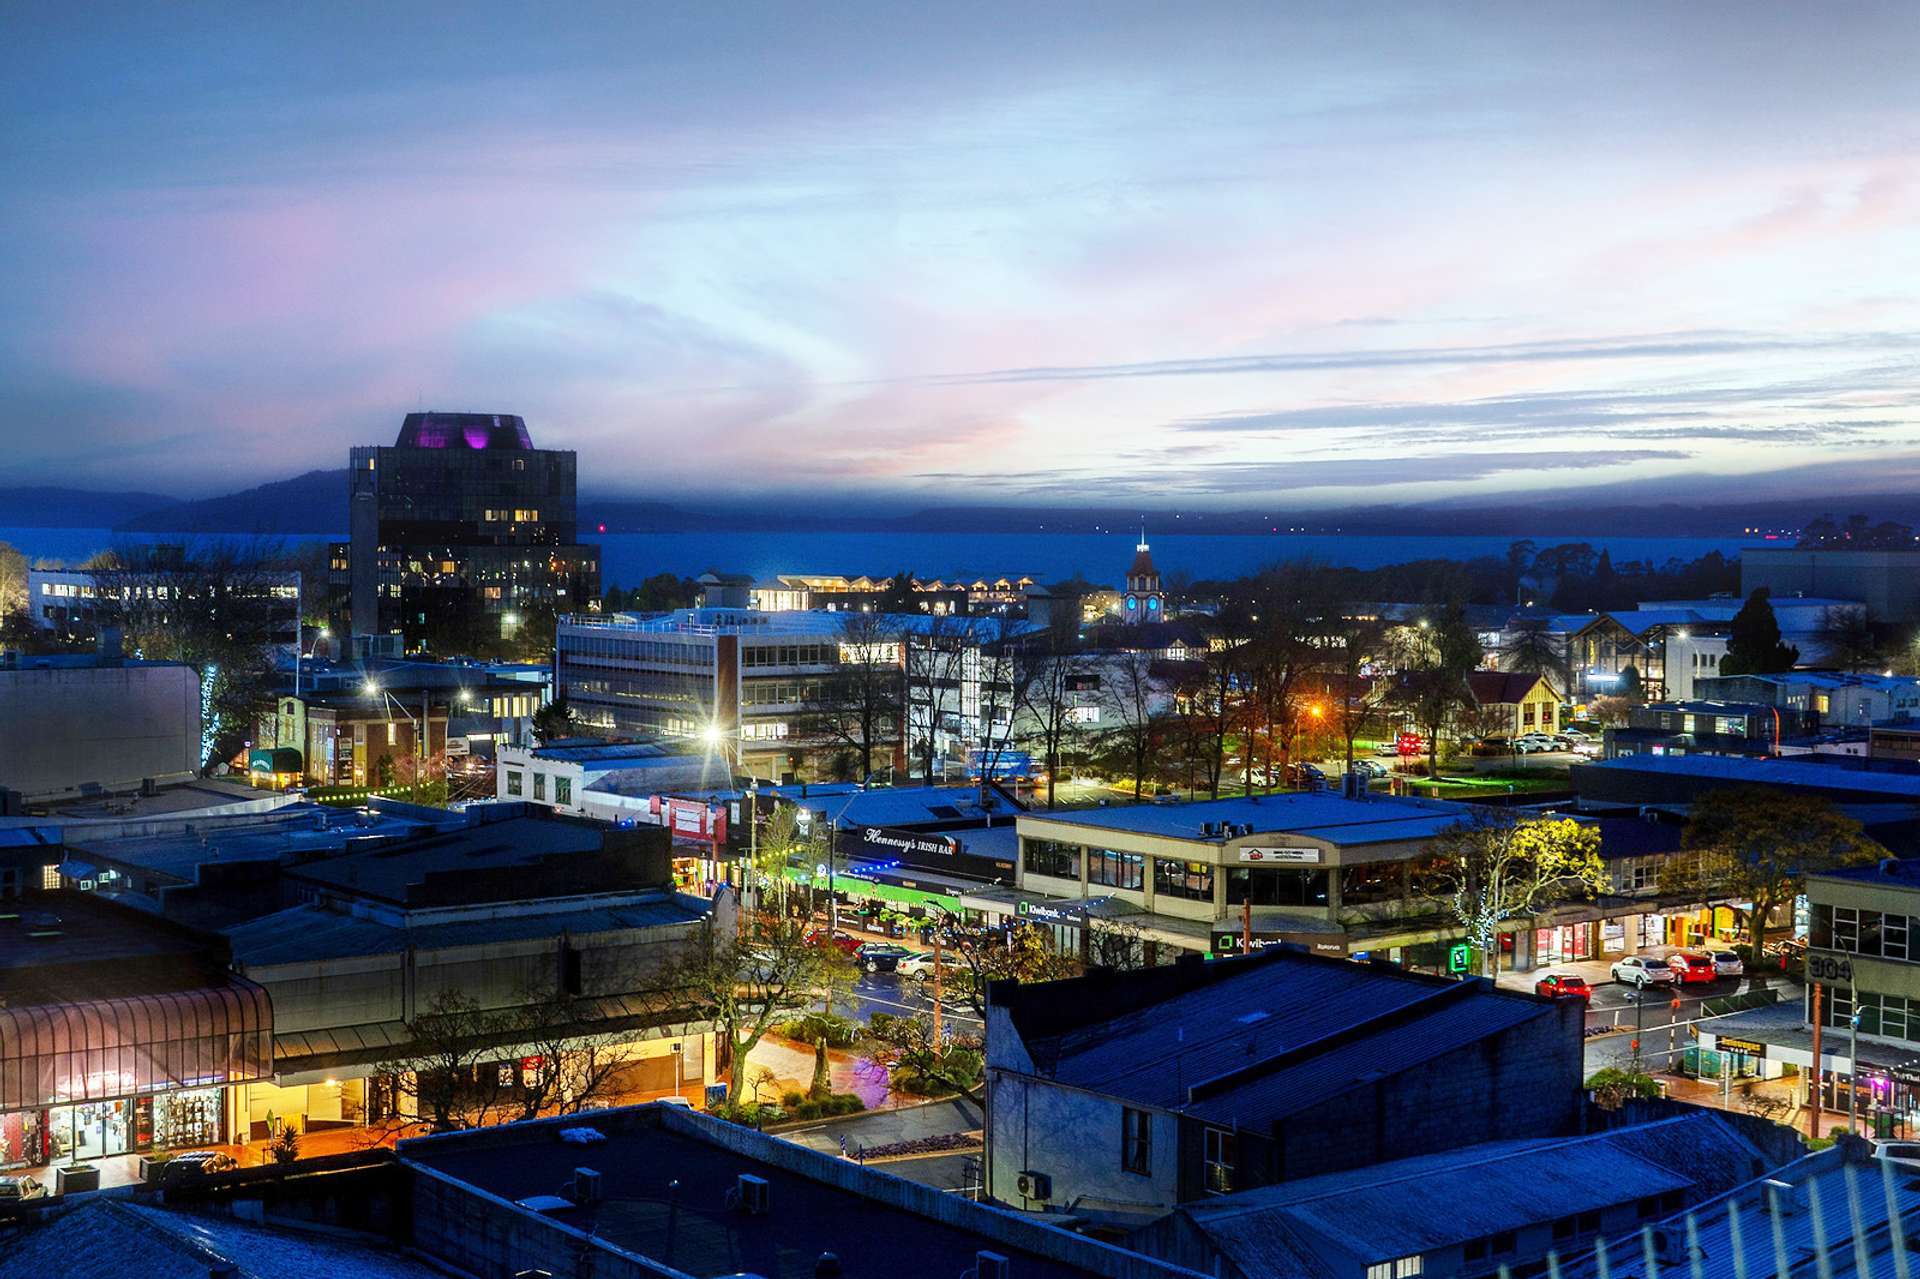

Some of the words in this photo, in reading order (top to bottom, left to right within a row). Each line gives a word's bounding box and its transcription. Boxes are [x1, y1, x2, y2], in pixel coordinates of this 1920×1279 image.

[863, 828, 916, 853] Hennessy's
[917, 841, 938, 853] IRISH
[938, 845, 954, 856] BAR
[1809, 955, 1852, 983] 304
